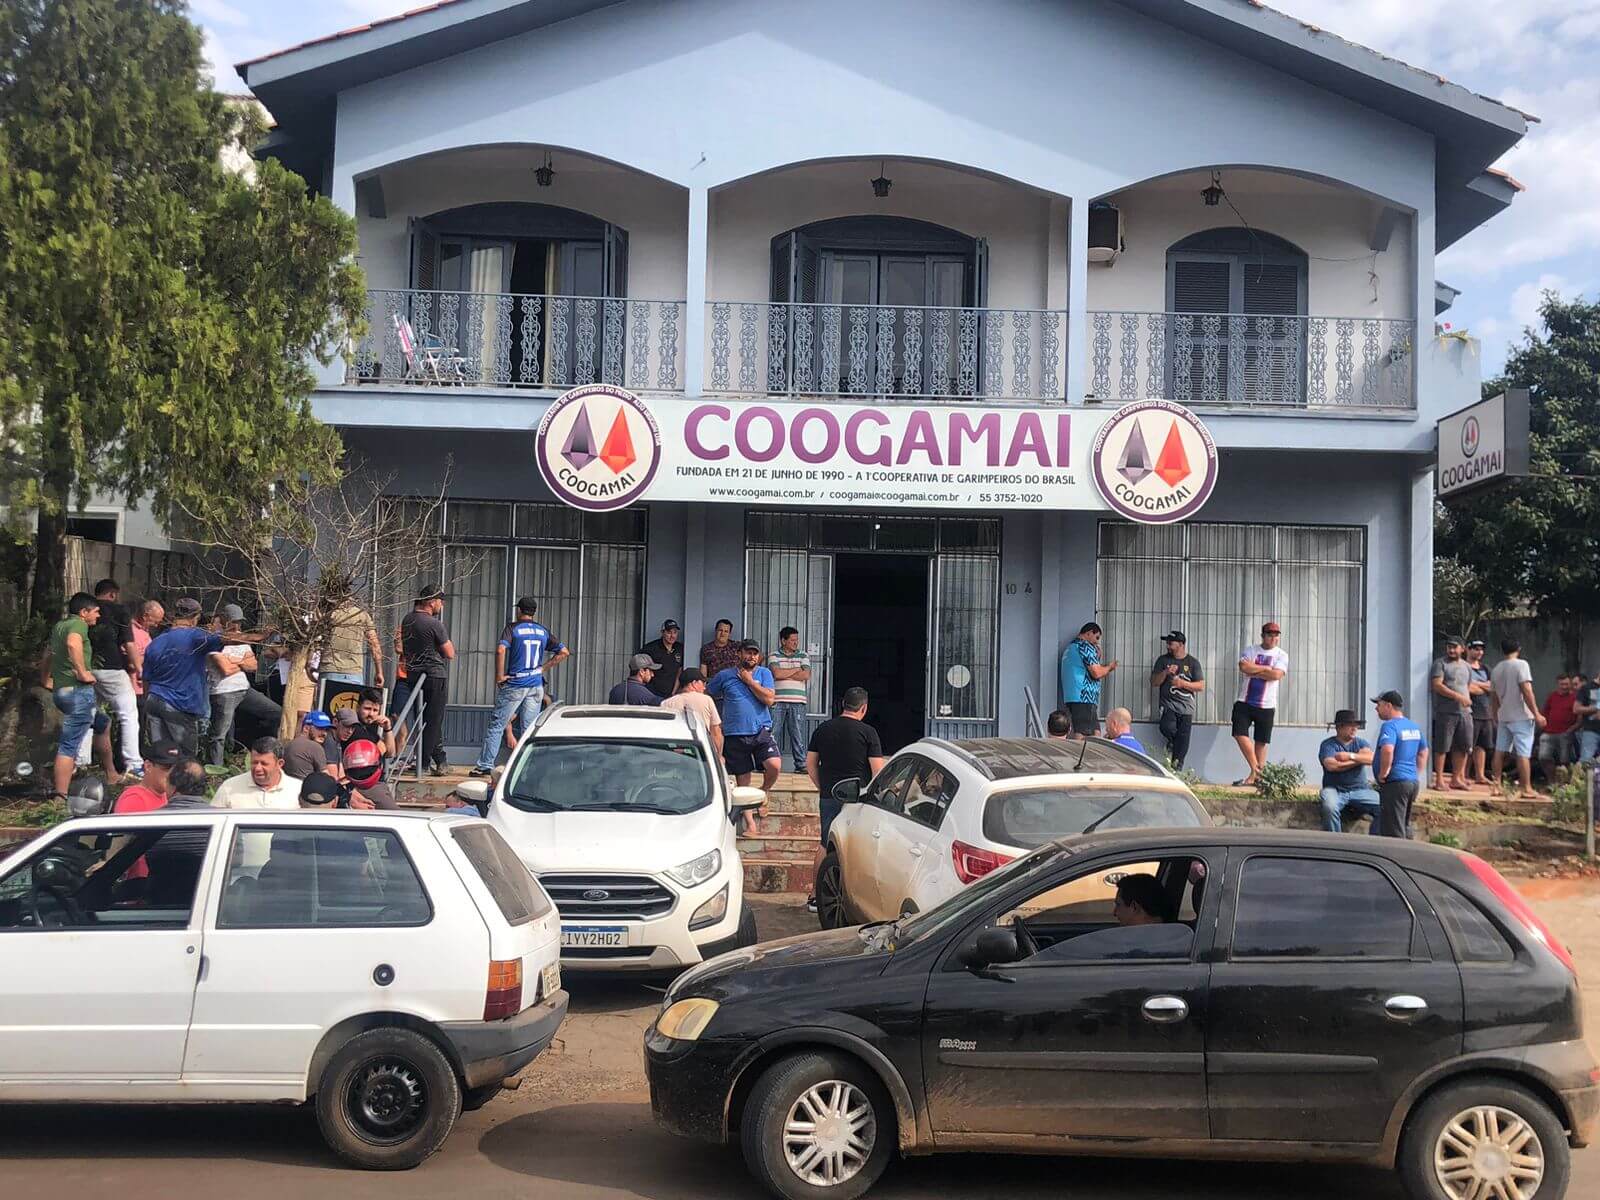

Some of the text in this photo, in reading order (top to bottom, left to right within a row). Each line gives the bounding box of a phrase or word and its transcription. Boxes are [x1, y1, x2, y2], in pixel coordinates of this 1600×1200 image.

[684, 404, 1072, 467] COOGAMAI
[558, 468, 636, 496] COOGAMAI
[676, 466, 722, 477] FUNDADA
[725, 467, 740, 478] EM
[742, 468, 753, 478] 21
[755, 469, 768, 479] DE
[771, 469, 803, 480] JUNHO
[805, 470, 818, 480] DE
[821, 470, 845, 480] 1990
[855, 471, 863, 480] A
[941, 473, 954, 483] DE
[957, 473, 1021, 484] GARIMPEIROS
[1024, 474, 1040, 484] DO
[1042, 474, 1076, 485] BRASIL
[1441, 450, 1501, 488] COOGAMAI
[709, 487, 815, 499] www.coogamai.com.br
[829, 491, 959, 502] coogamai@coogamai.com.br
[980, 493, 992, 502] 55
[994, 493, 1043, 503] 3752-1020
[1115, 483, 1192, 510] COOGAMAI
[523, 639, 542, 669] 17
[566, 932, 621, 945] IYY2H02
